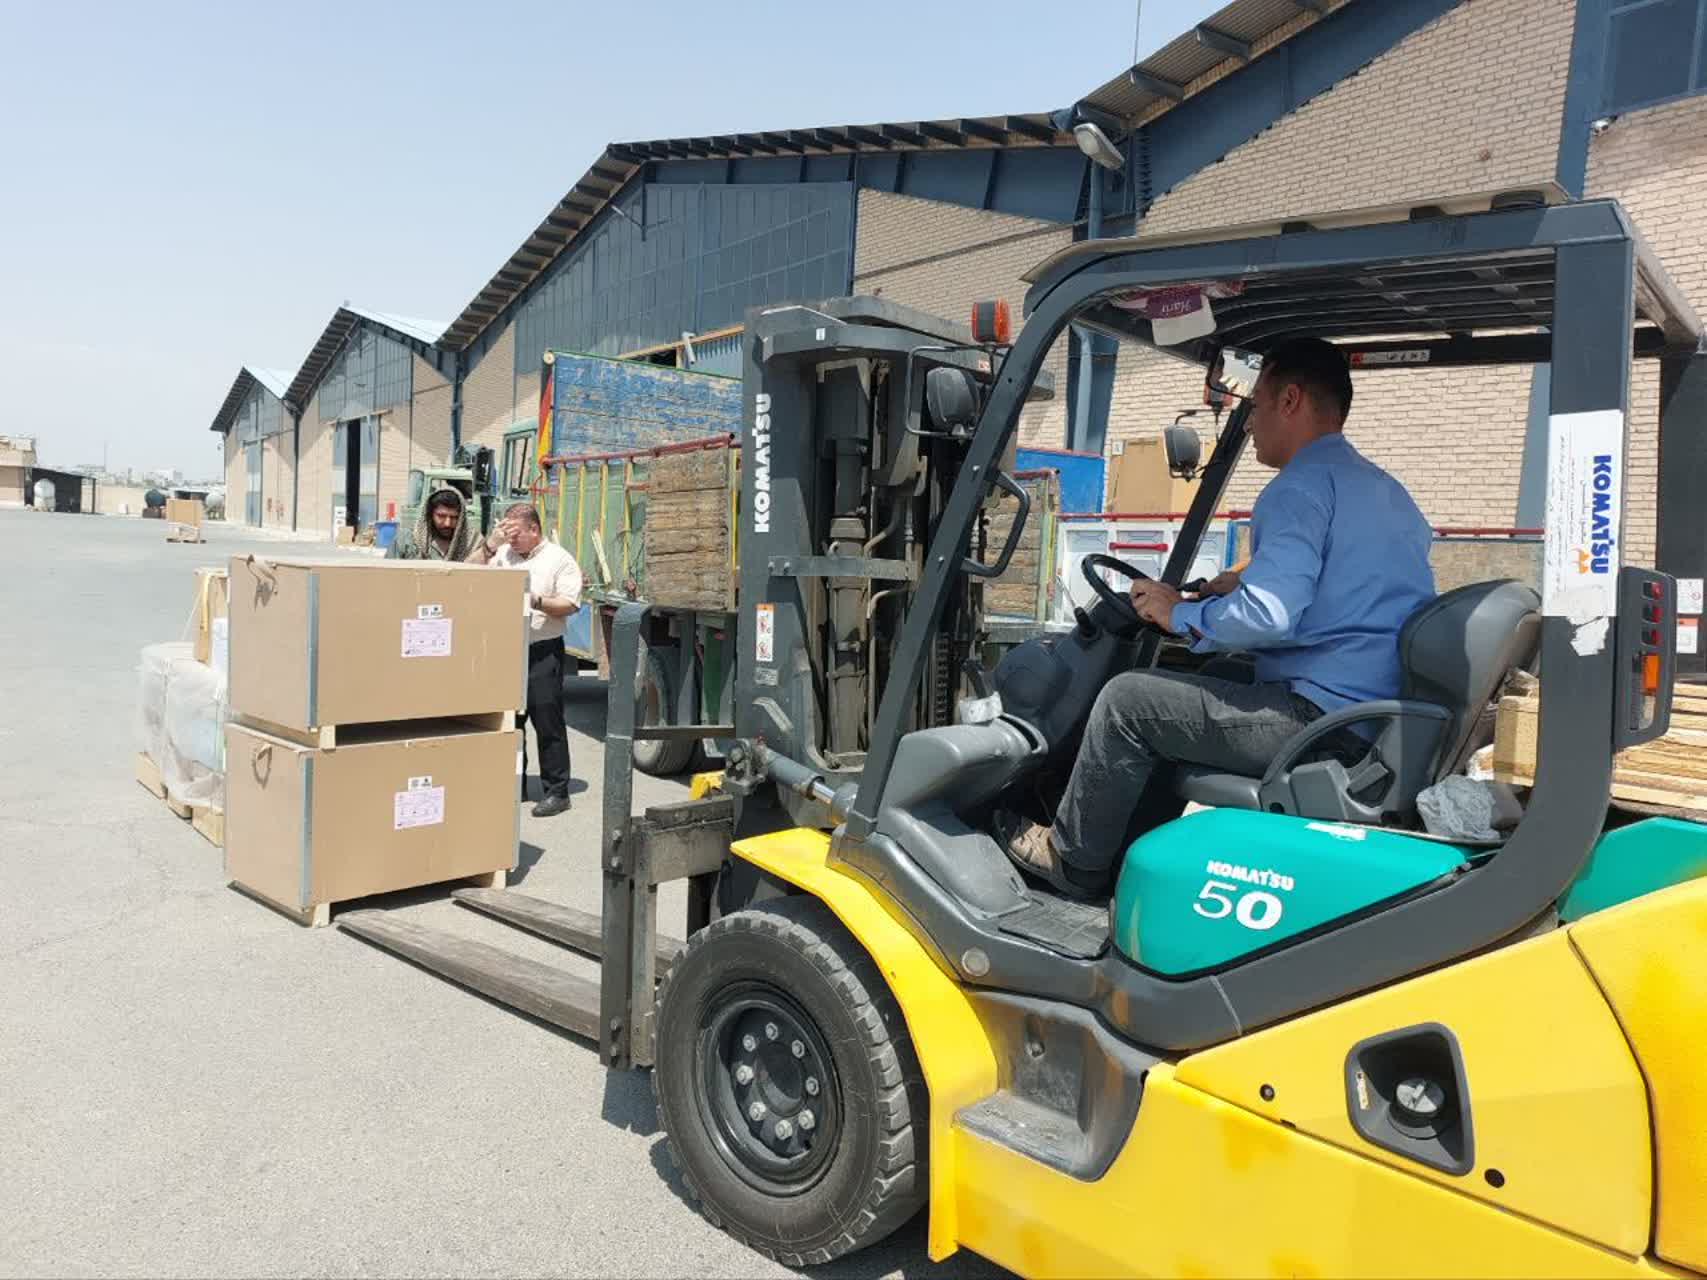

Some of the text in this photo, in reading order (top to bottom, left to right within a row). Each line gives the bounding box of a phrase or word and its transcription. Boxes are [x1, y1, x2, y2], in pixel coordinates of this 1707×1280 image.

[752, 393, 771, 533] KOMATSU
[1590, 455, 1615, 574] KOMATSU
[1193, 880, 1282, 930] 50
[1206, 860, 1294, 891] KOMATSU
